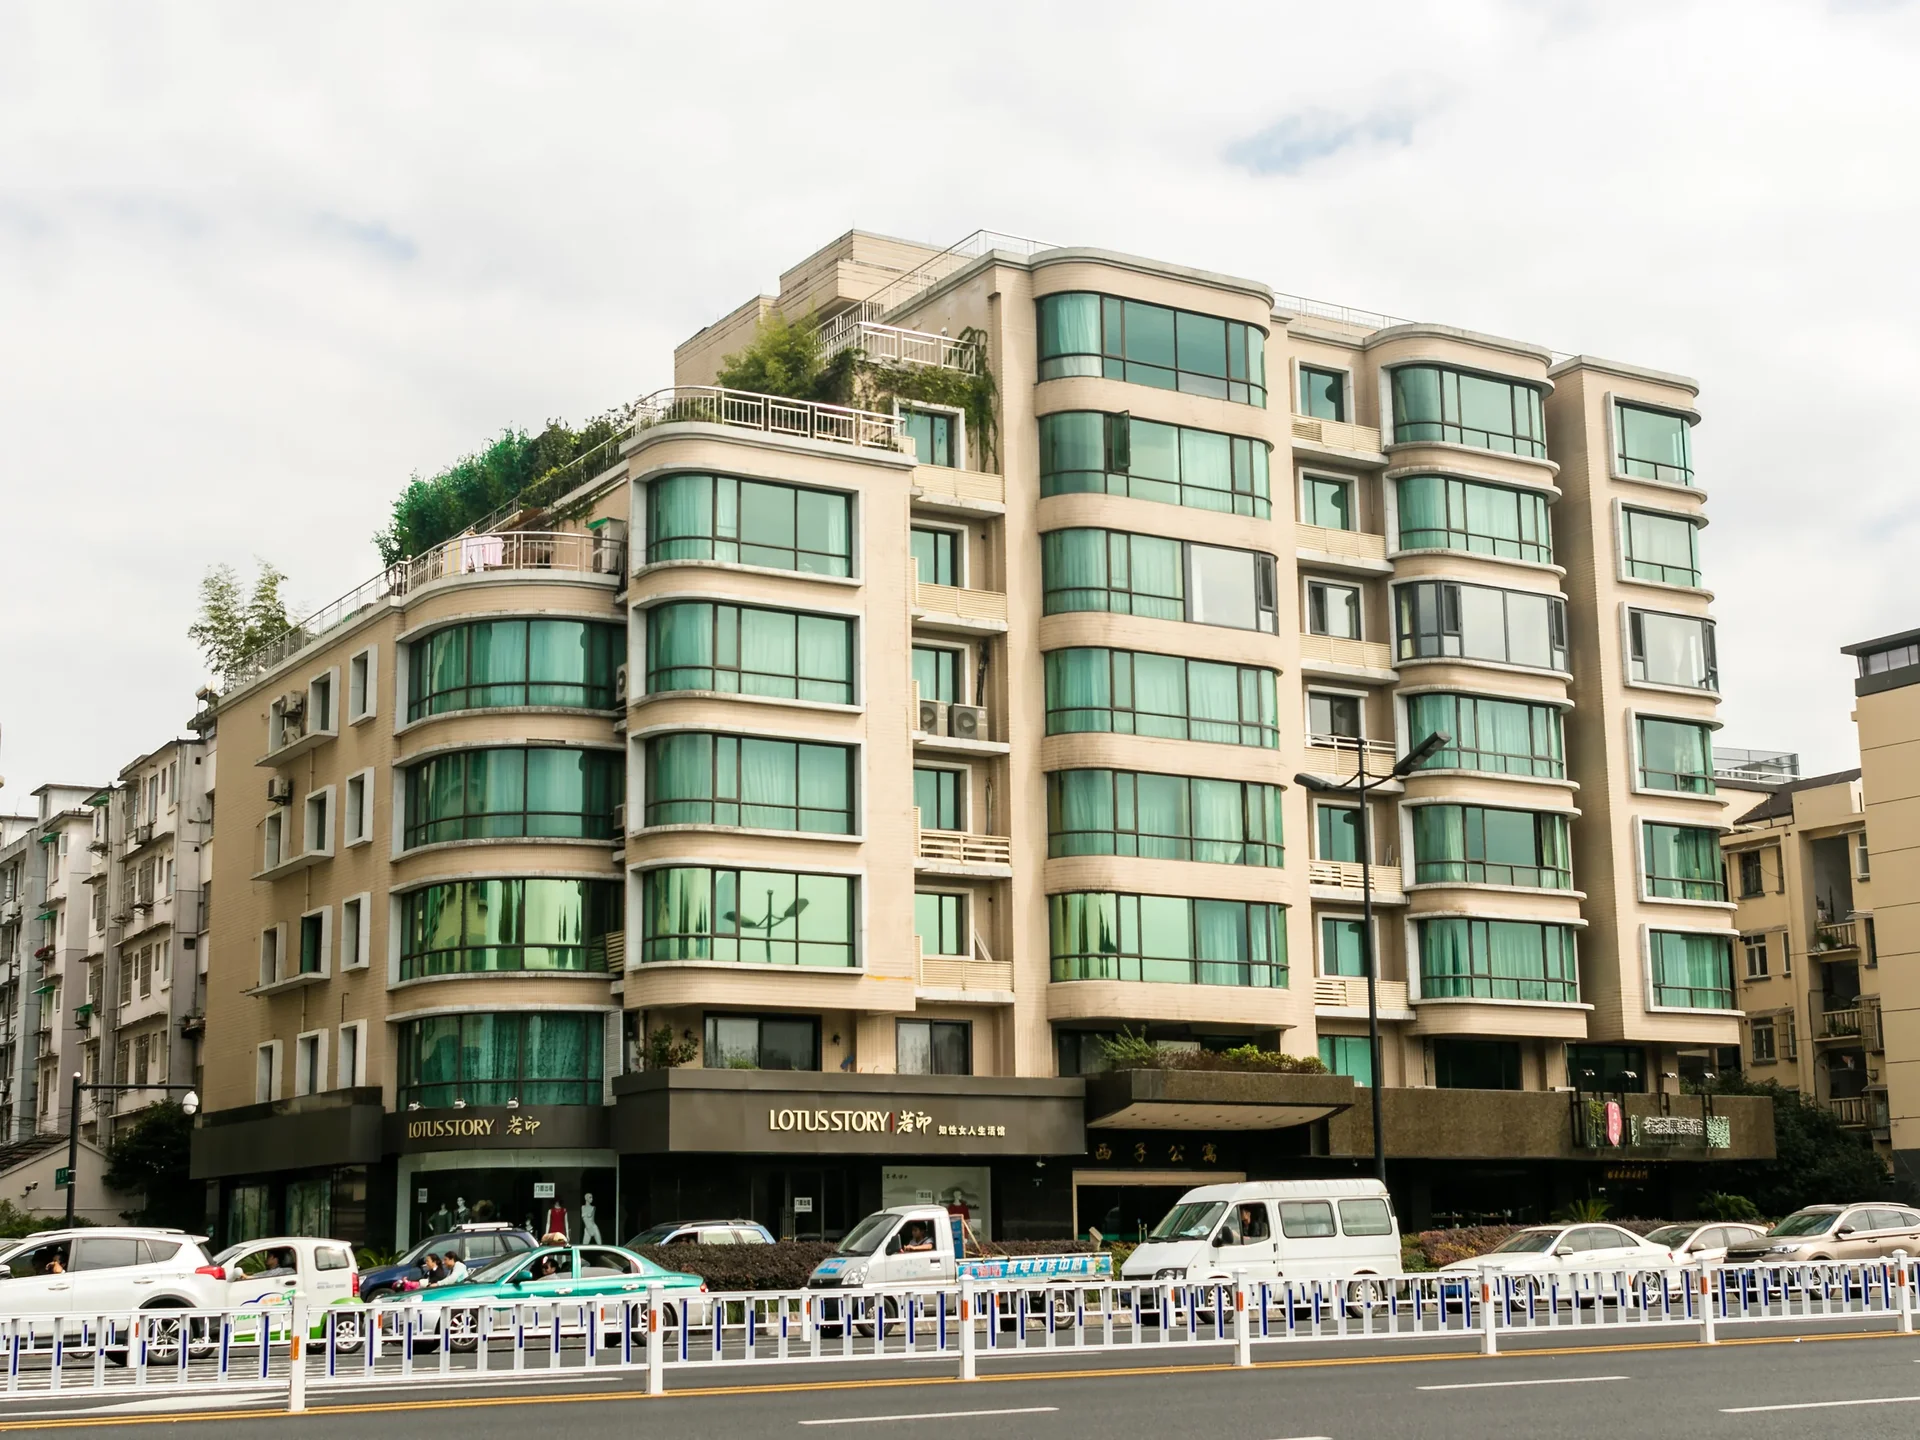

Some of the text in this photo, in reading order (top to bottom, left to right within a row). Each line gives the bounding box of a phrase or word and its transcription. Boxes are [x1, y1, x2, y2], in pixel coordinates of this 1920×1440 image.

[938, 1125, 1006, 1136] 知性女人生活馆
[1095, 1142, 1217, 1164] 西子公寓
